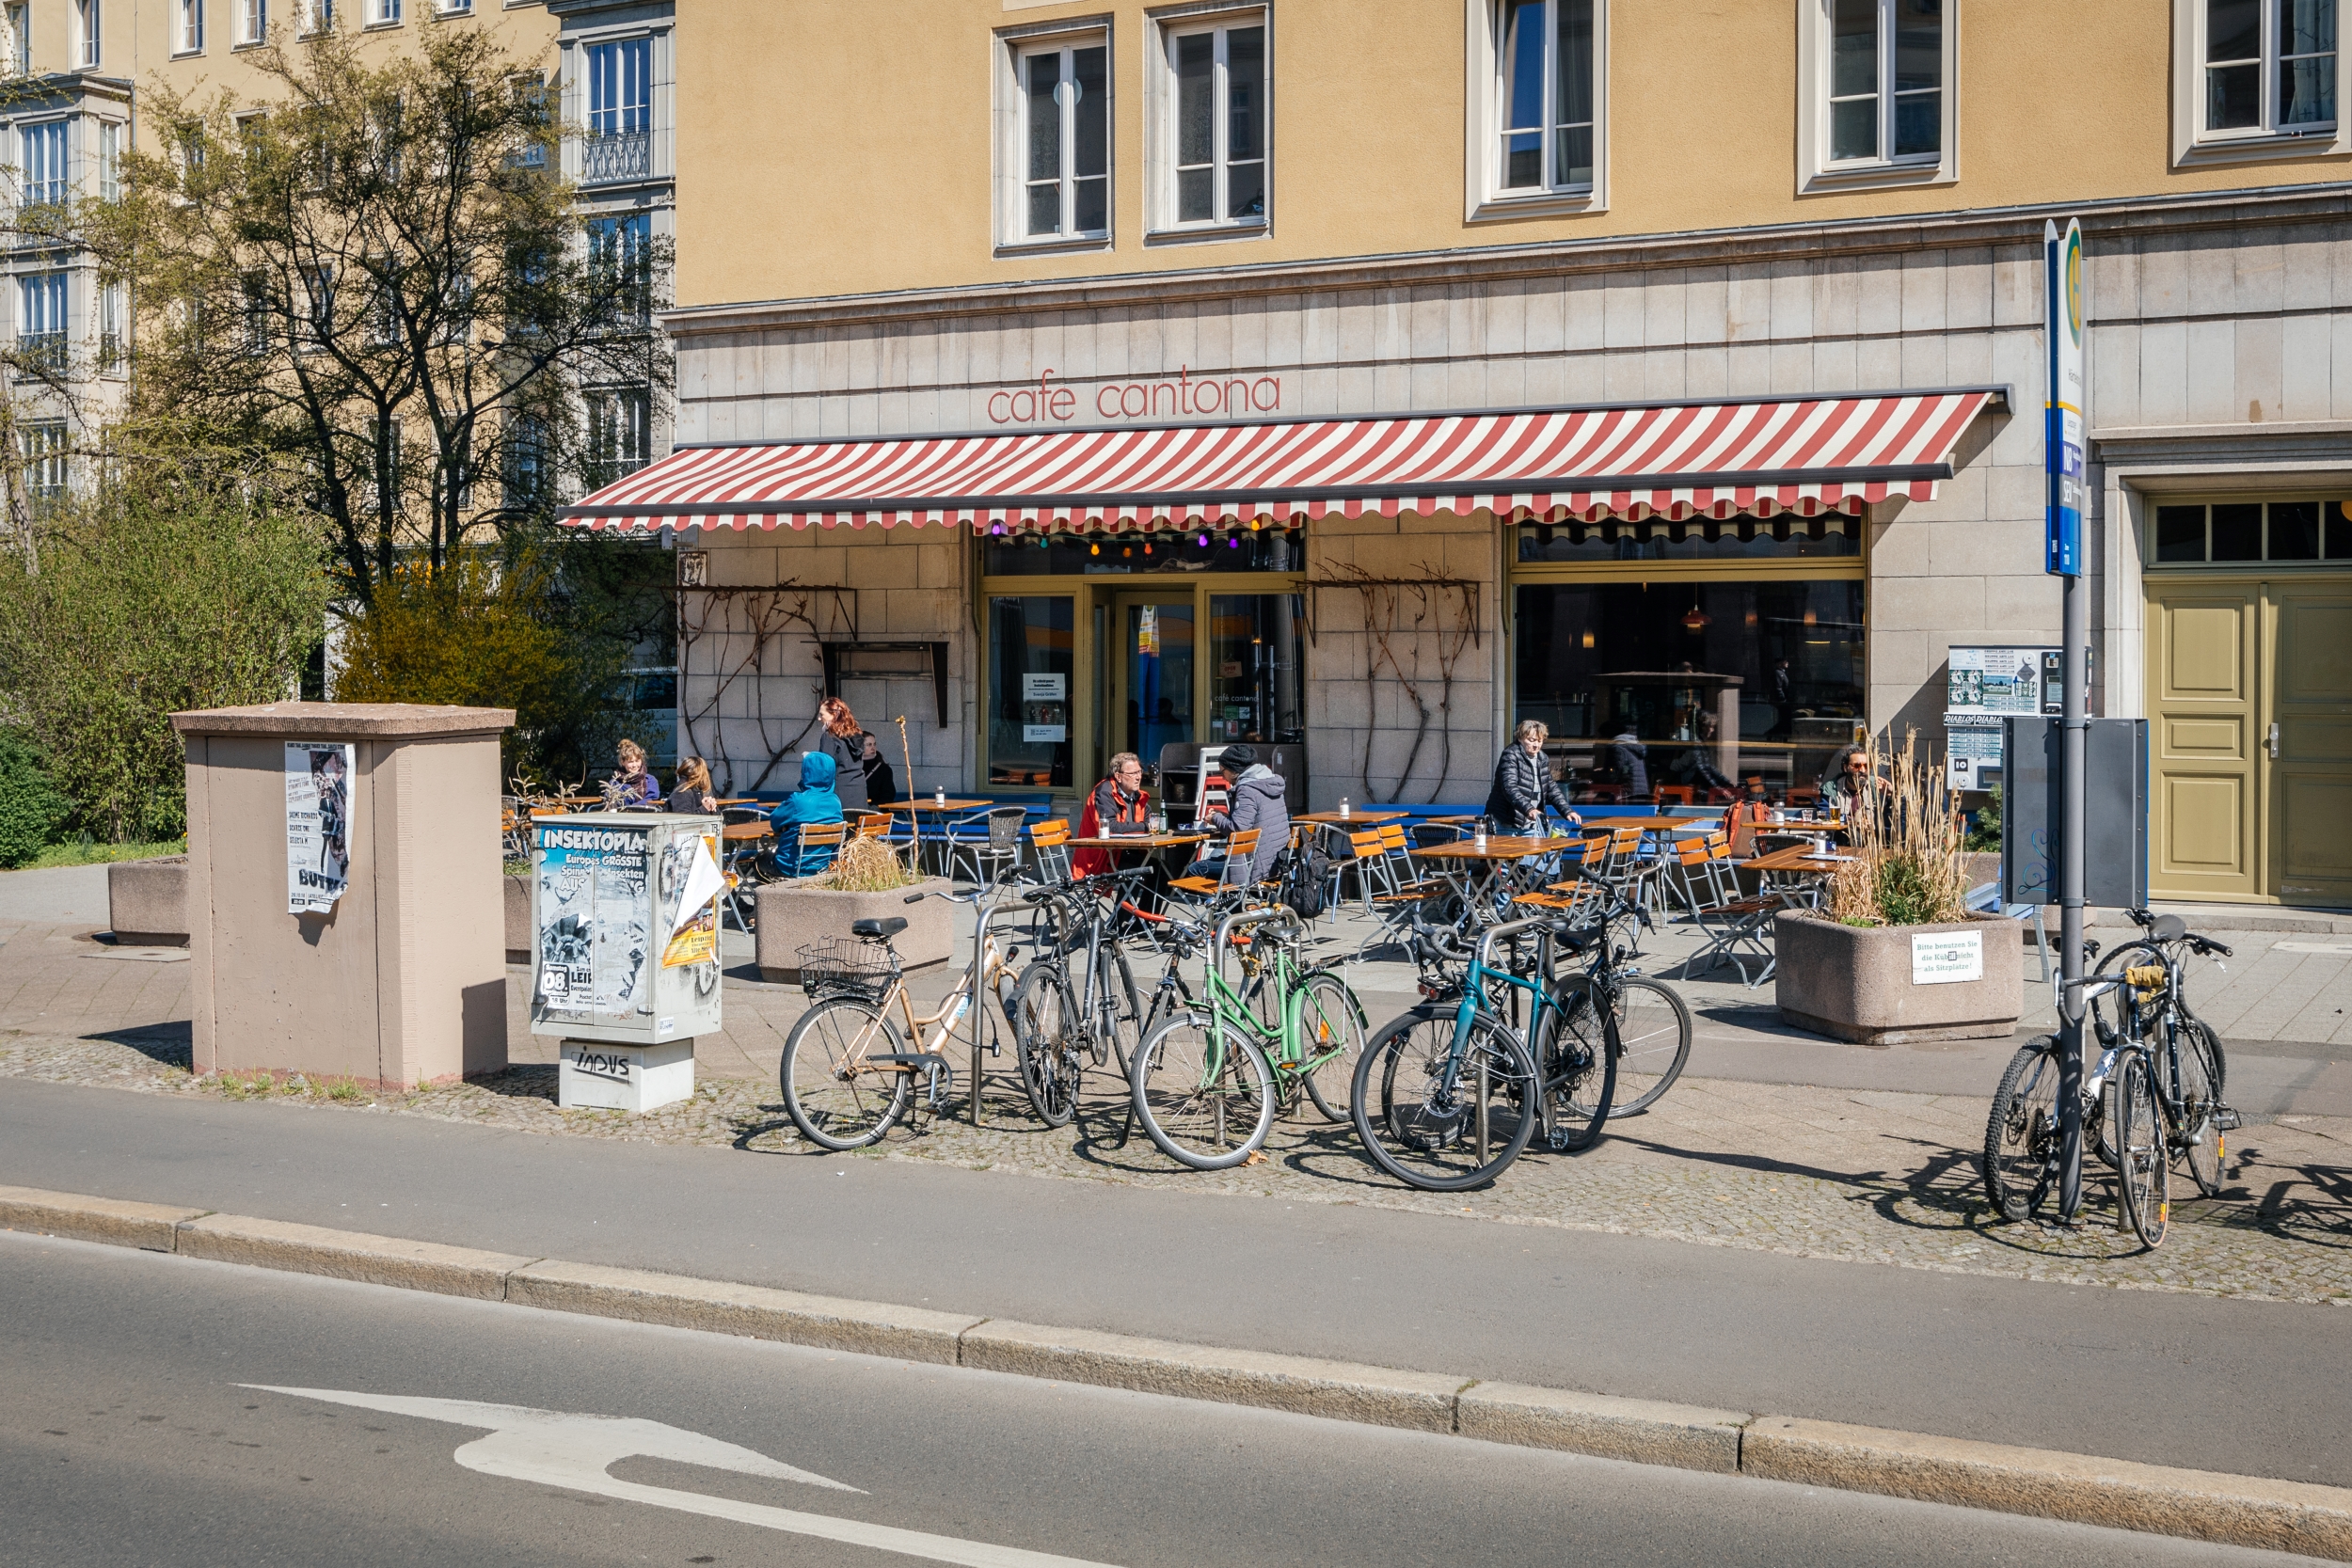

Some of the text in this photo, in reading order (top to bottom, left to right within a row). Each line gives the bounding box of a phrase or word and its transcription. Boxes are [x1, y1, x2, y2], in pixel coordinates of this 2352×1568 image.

[988, 364, 1280, 423] cafe cantona
[2063, 445, 2073, 472] N8
[2063, 480, 2073, 503] SEV
[1214, 693, 1229, 701] café
[544, 829, 644, 851] INSEKTOPIA
[565, 853, 600, 866] Europas
[544, 971, 568, 990] 08.
